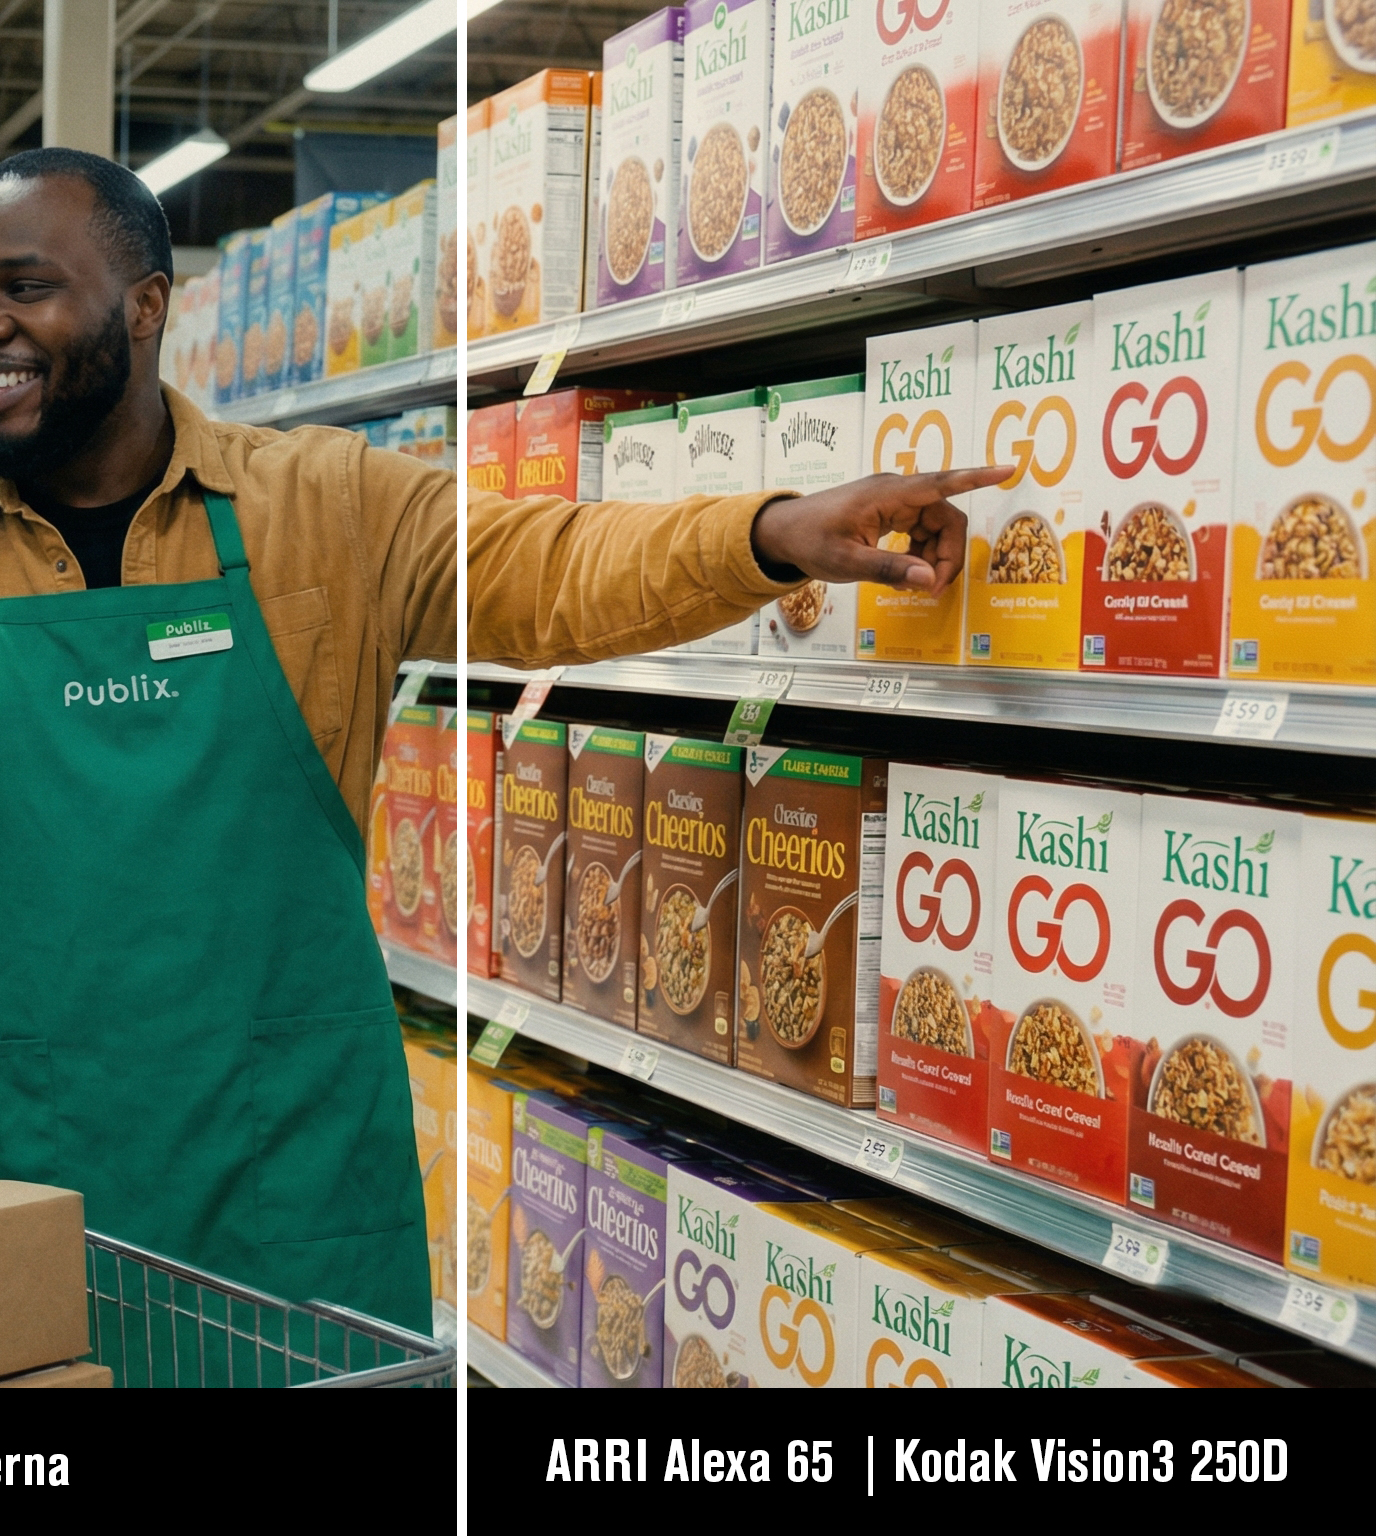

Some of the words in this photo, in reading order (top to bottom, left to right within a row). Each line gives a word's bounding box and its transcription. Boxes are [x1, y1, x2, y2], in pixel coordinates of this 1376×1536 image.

[695, 20, 748, 81] Kashi
[610, 62, 654, 116] Kashi
[992, 322, 1081, 390] Kashi
[1110, 300, 1211, 371] Kashi
[879, 345, 955, 403] Kashi
[873, 409, 954, 476] GO
[986, 395, 1077, 490] GO
[1102, 376, 1208, 479] GO
[1255, 354, 1376, 468] GO
[503, 773, 558, 821] Cheerios
[569, 786, 634, 838] Cheerios
[646, 801, 726, 858] Cheerios
[901, 791, 985, 850] Kashi
[747, 817, 846, 879] Cheerios
[1016, 811, 1113, 873] Kashi
[1163, 829, 1275, 898] Kashi
[896, 851, 981, 951] GO
[1007, 875, 1111, 982] GO
[1153, 898, 1272, 1018] GO
[588, 1186, 658, 1261] Cheerios
[677, 1194, 740, 1261] Kashi
[674, 1249, 736, 1330] GO
[766, 1240, 836, 1306] Kashi
[759, 1284, 835, 1387] GO
[872, 1284, 955, 1357] Kashi
